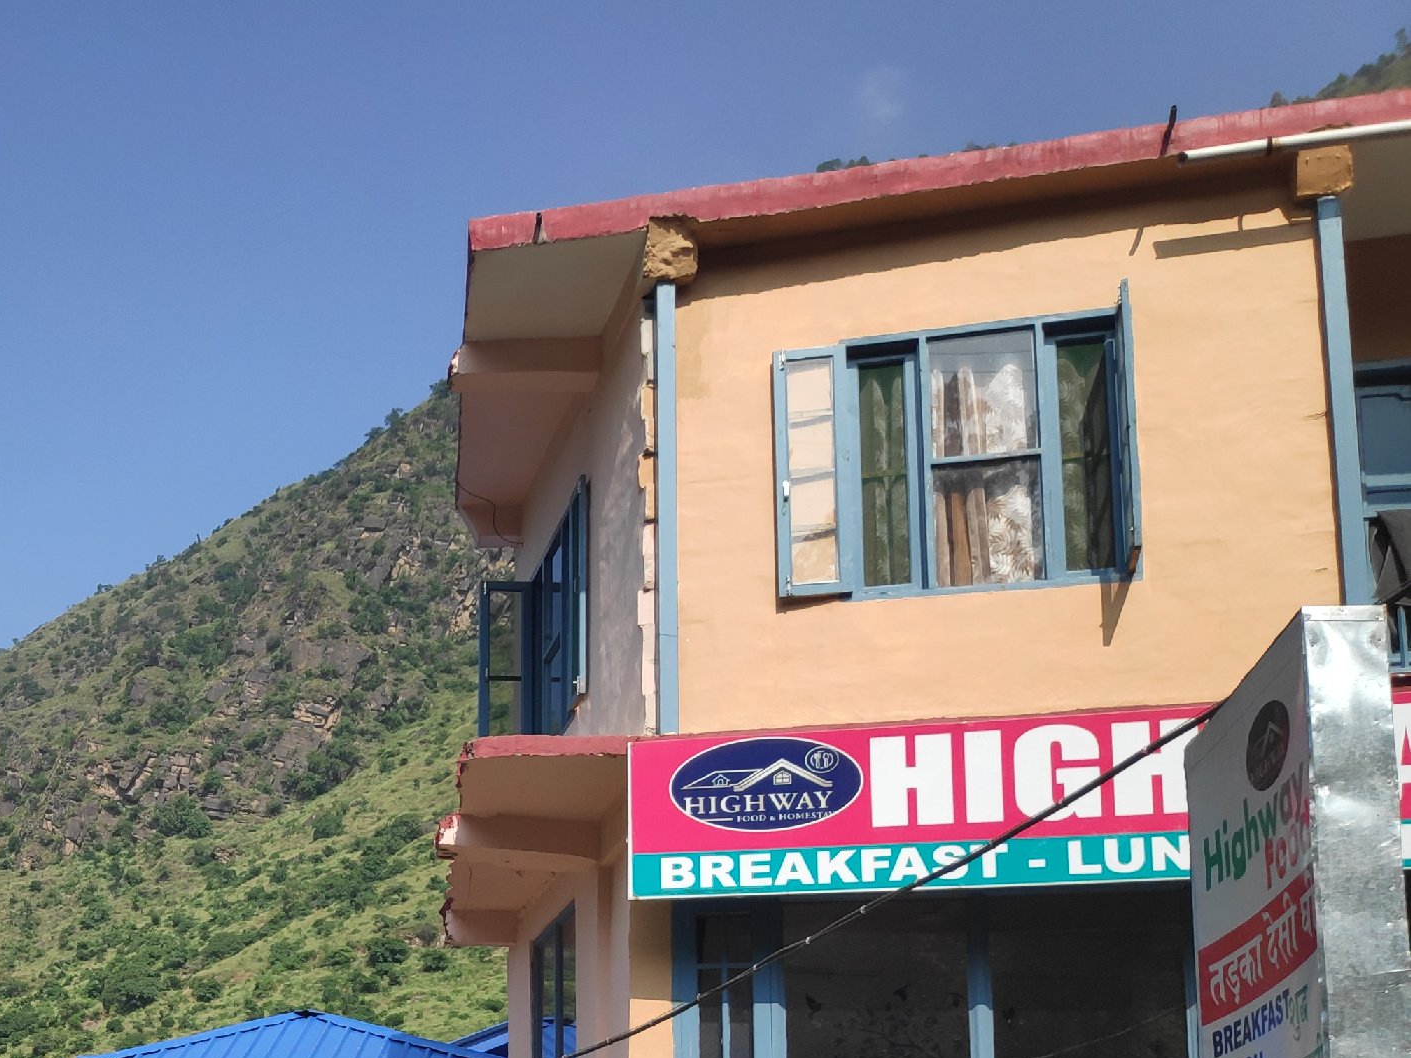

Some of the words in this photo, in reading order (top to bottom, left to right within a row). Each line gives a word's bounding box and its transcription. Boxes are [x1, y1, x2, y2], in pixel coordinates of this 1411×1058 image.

[683, 791, 833, 815] HIGHWAY
[869, 718, 1201, 828] HIGH
[736, 814, 767, 823] FOOD
[1203, 761, 1305, 892] Highway
[660, 844, 1009, 889] BREAKFAST
[1067, 835, 1190, 875] LUN
[1212, 988, 1290, 1058] BREAKFAST
